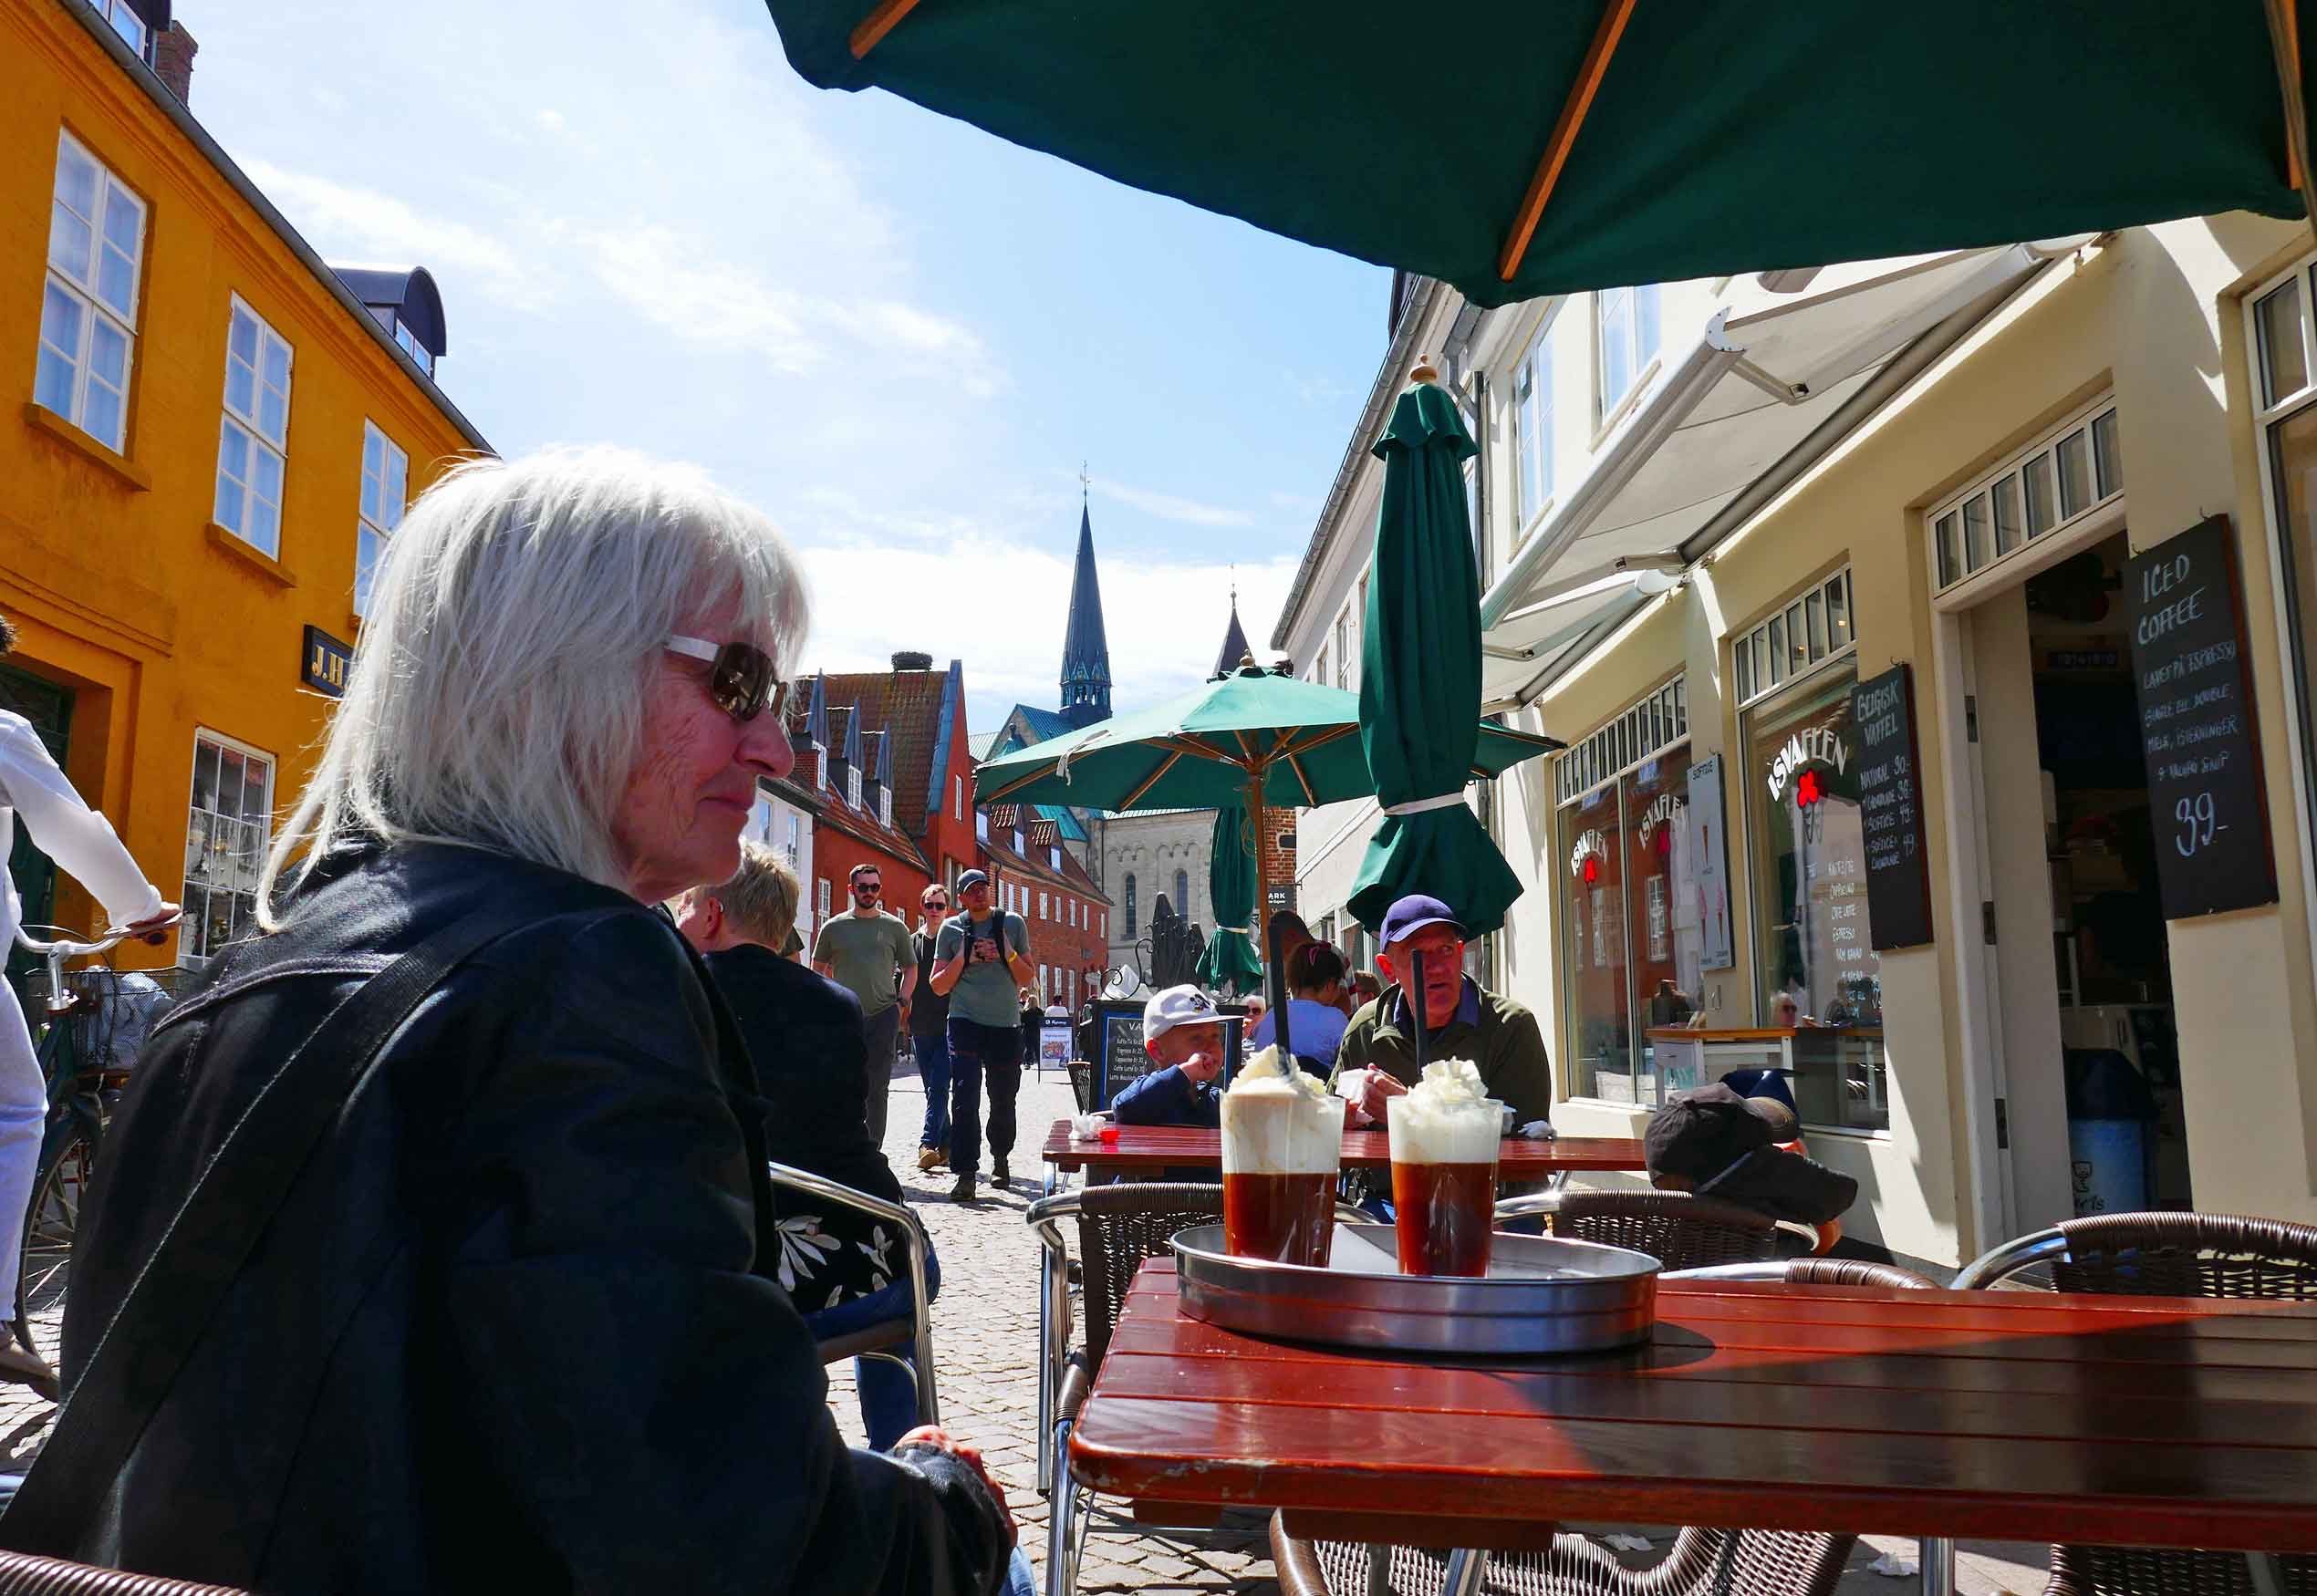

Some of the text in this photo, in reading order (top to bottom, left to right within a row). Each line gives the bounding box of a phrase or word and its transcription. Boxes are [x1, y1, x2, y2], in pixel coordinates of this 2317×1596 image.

[2143, 554, 2190, 604] ICED
[2137, 586, 2207, 646] COFFEE
[2189, 640, 2237, 671] ESPRESSO
[1857, 679, 1898, 722] BELGISK
[1767, 727, 1848, 802] ISVAFLEN
[1571, 829, 1608, 876] ISVAFLEN
